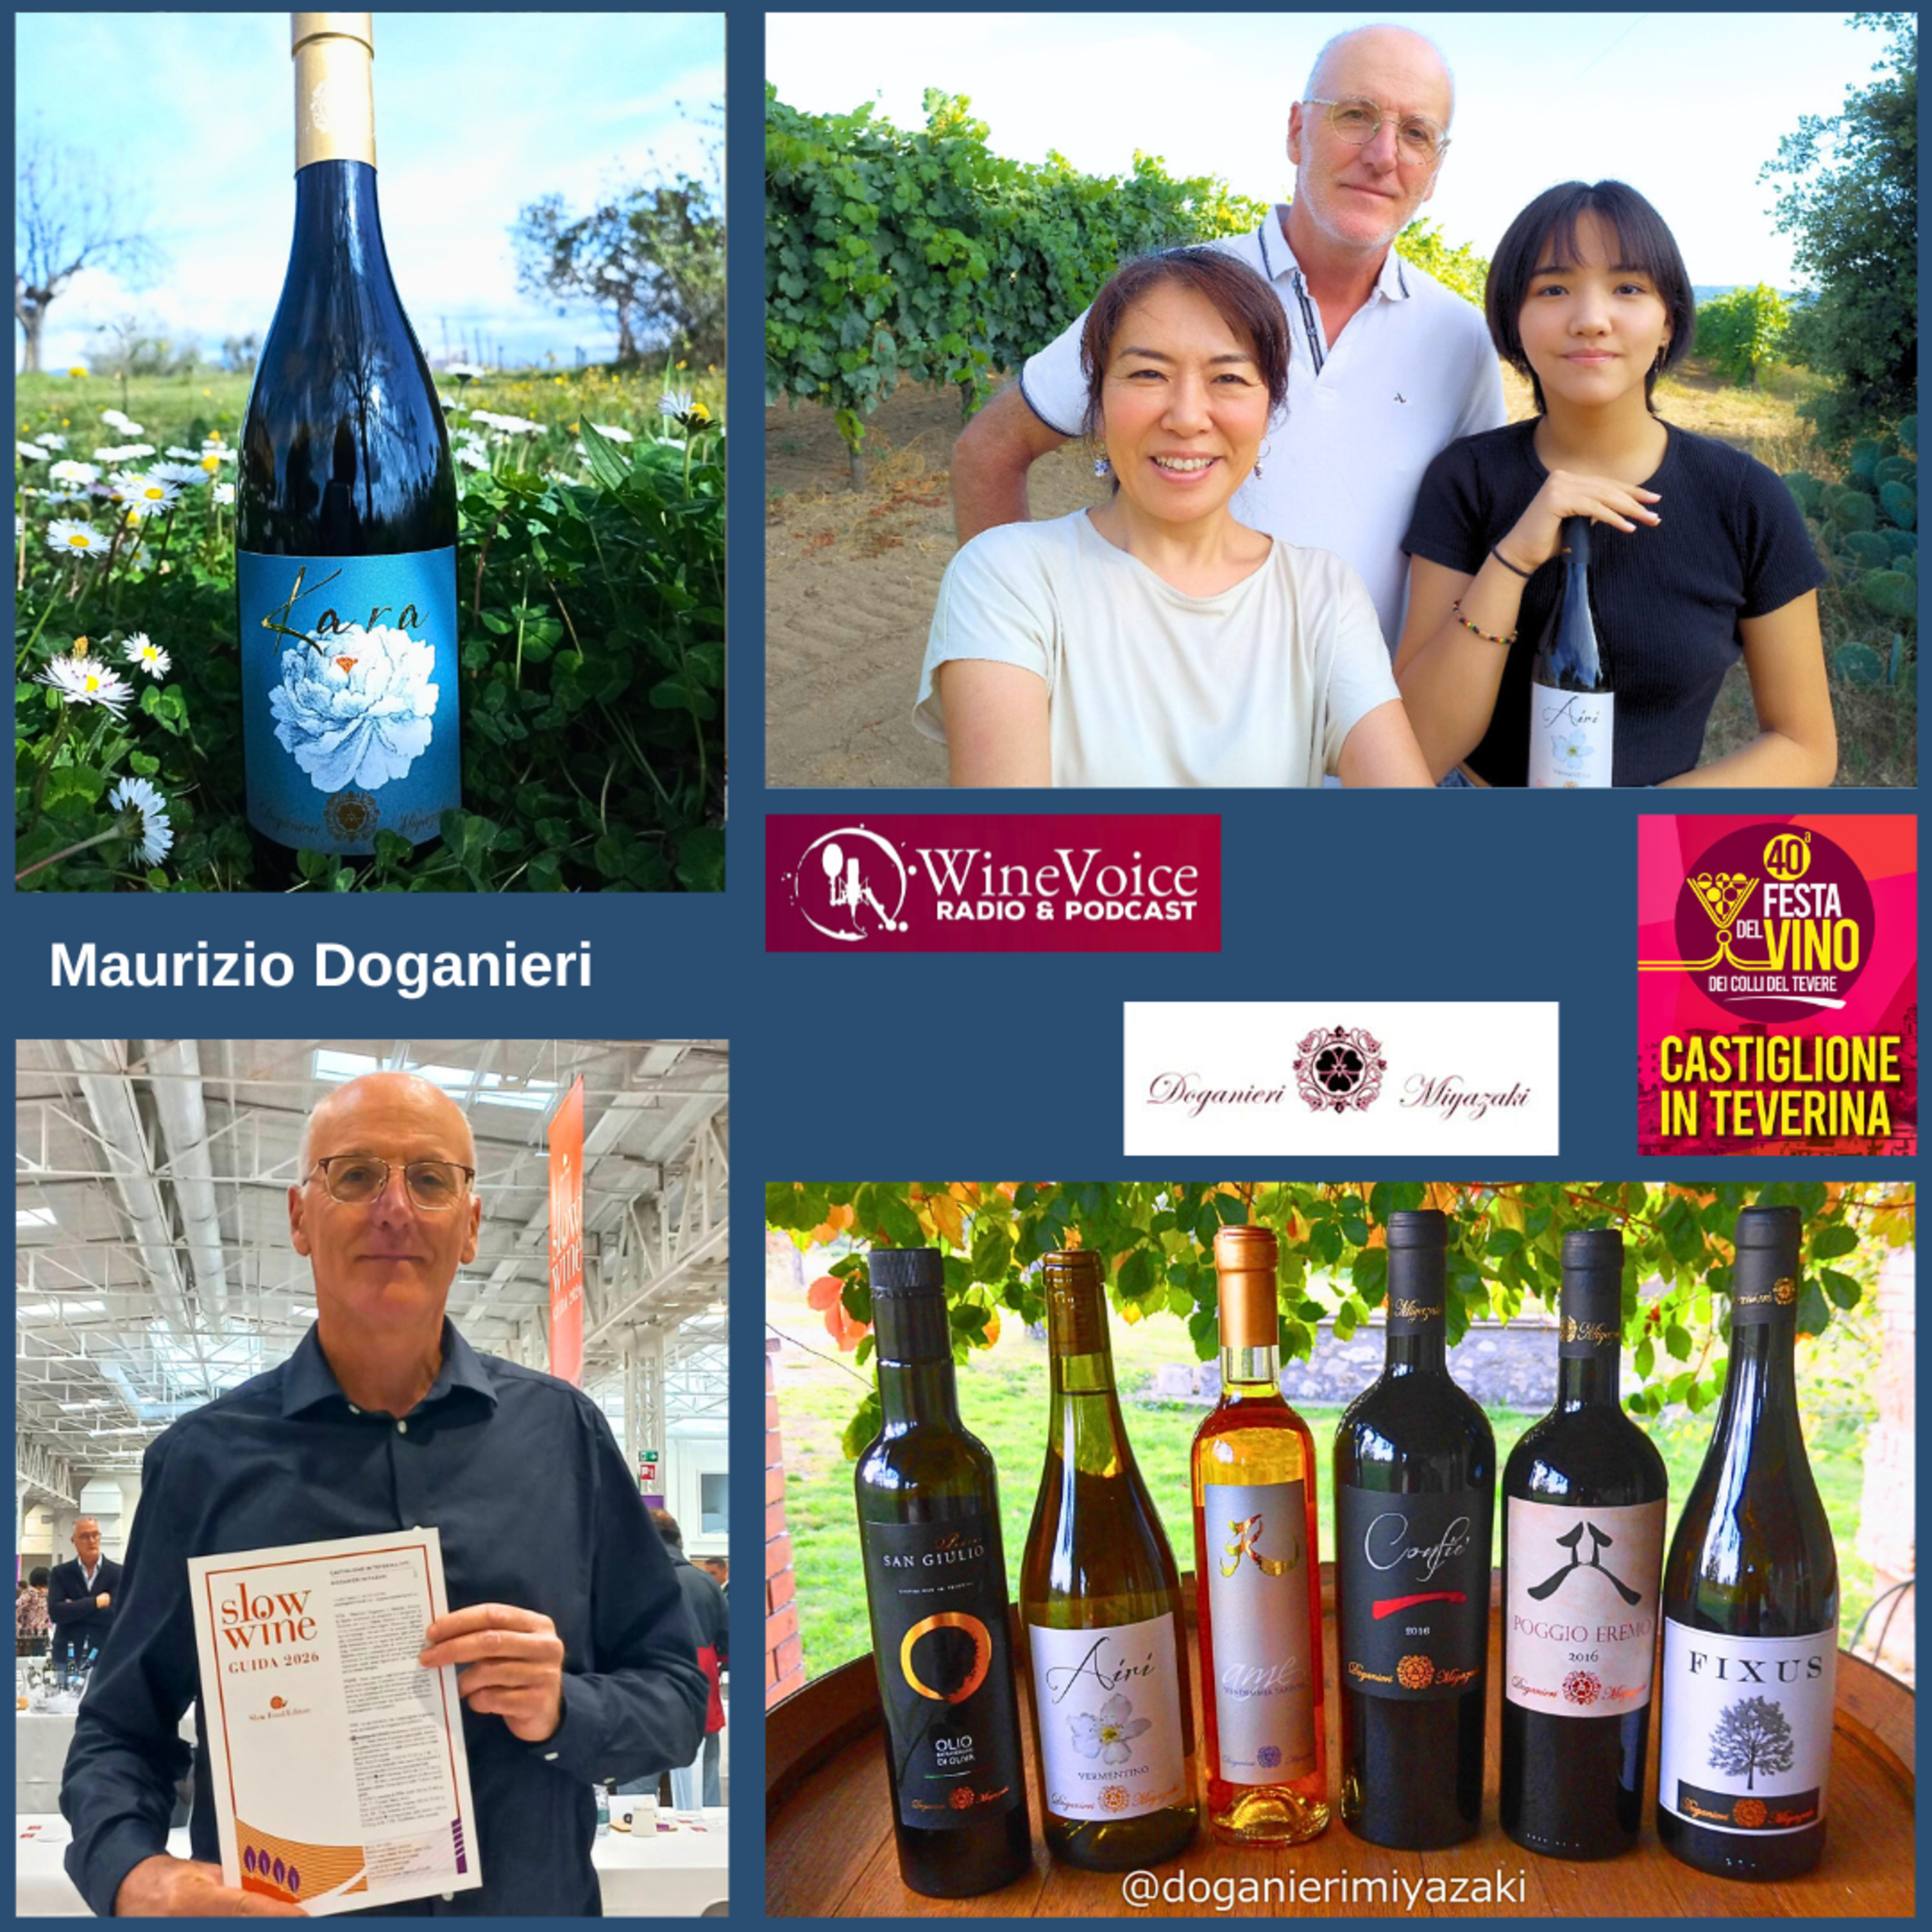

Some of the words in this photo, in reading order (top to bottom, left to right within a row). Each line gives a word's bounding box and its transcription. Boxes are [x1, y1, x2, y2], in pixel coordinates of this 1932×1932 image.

[261, 565, 430, 656] Kara
[883, 1554, 914, 1568] SAN
[922, 1545, 985, 1567] GIULIO
[221, 1582, 312, 1625] slow
[222, 1616, 317, 1651] wine
[1405, 1626, 1430, 1636] 2016
[1513, 1615, 1589, 1643] POGGIO
[1596, 1618, 1653, 1643] EREMO
[228, 1657, 279, 1674] GUIDA
[284, 1651, 319, 1667] 2026
[1568, 1650, 1599, 1662] 2016
[1688, 1649, 1823, 1684] FIXUS
[936, 1735, 972, 1752] OLIO
[1077, 1765, 1150, 1781] VERMENTINO
